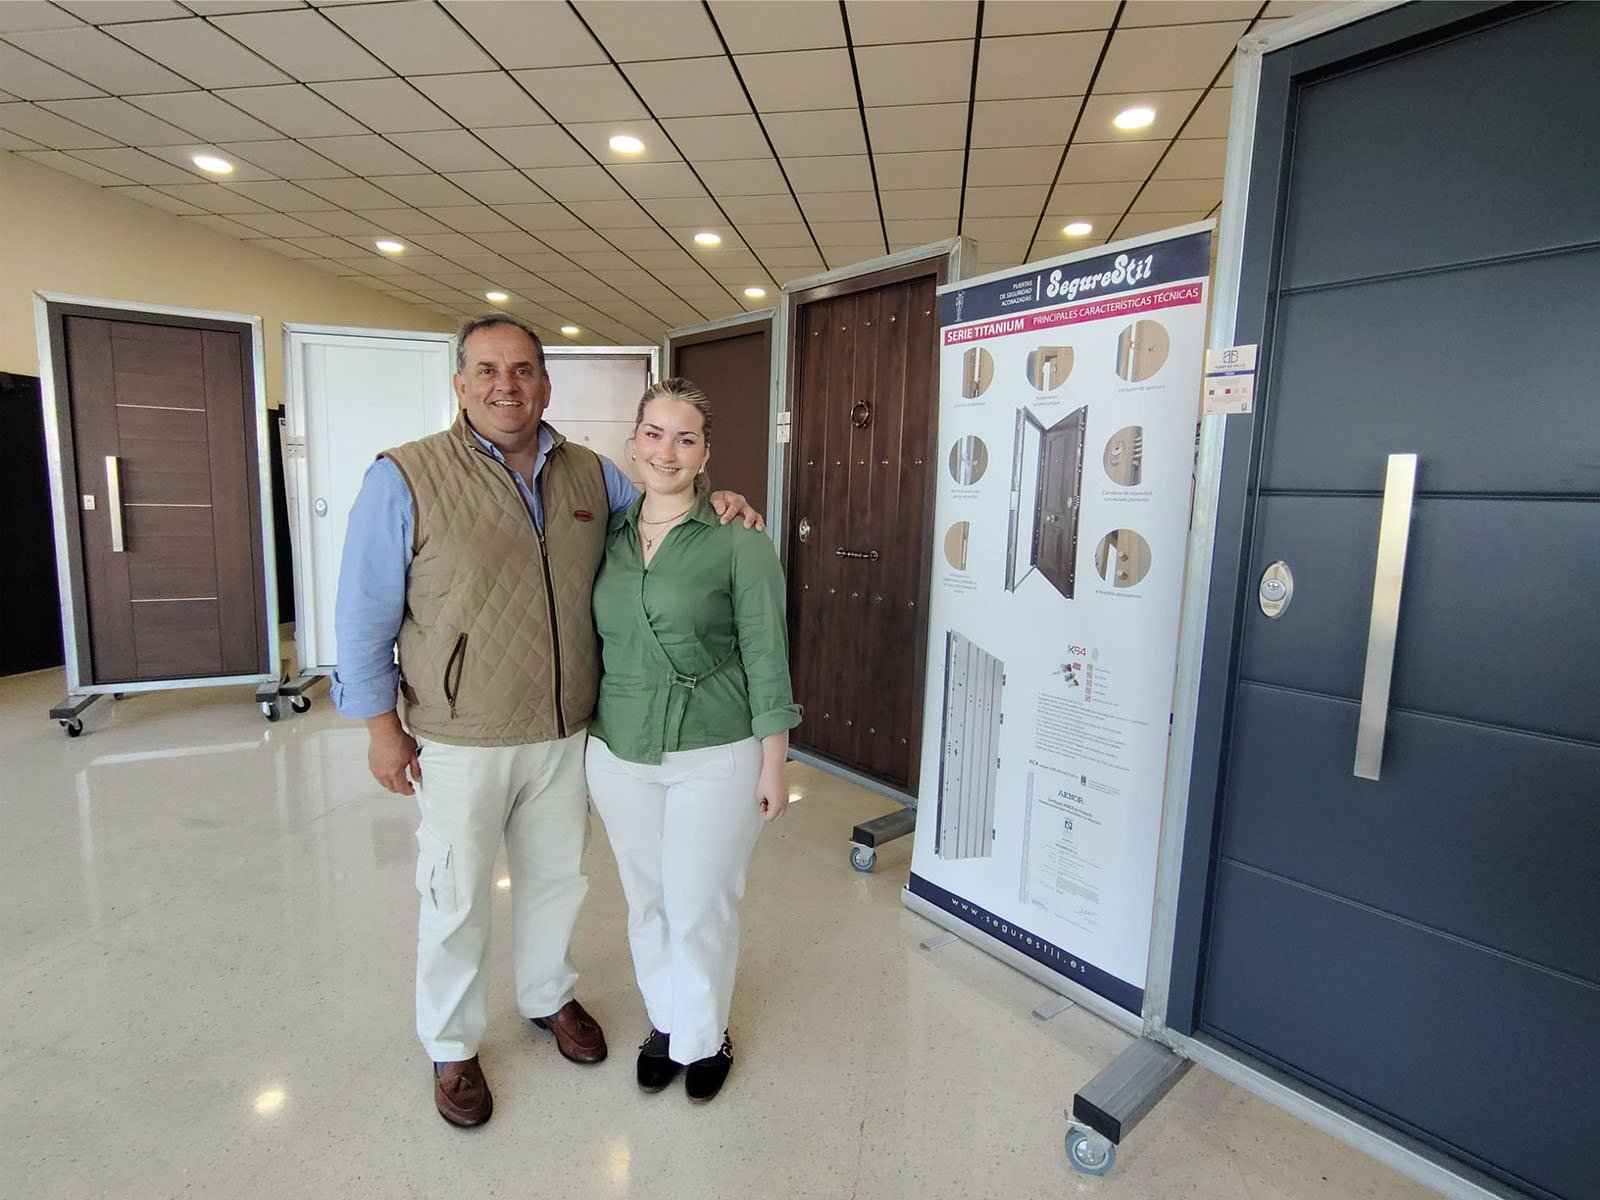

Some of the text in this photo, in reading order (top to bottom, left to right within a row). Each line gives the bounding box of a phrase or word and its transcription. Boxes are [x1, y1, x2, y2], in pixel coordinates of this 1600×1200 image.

[1012, 280, 1032, 290] PUERTAS
[1046, 254, 1154, 300] SegureStil
[1001, 295, 1032, 306] ACORAZADAS
[1006, 287, 1032, 298] SEGURIDAD
[947, 287, 1199, 343] SERIE TITANIUM PRINCIPALES CARACTERÍSTICAS TÉCNICAS
[951, 898, 1086, 973] www.segurestil.es
